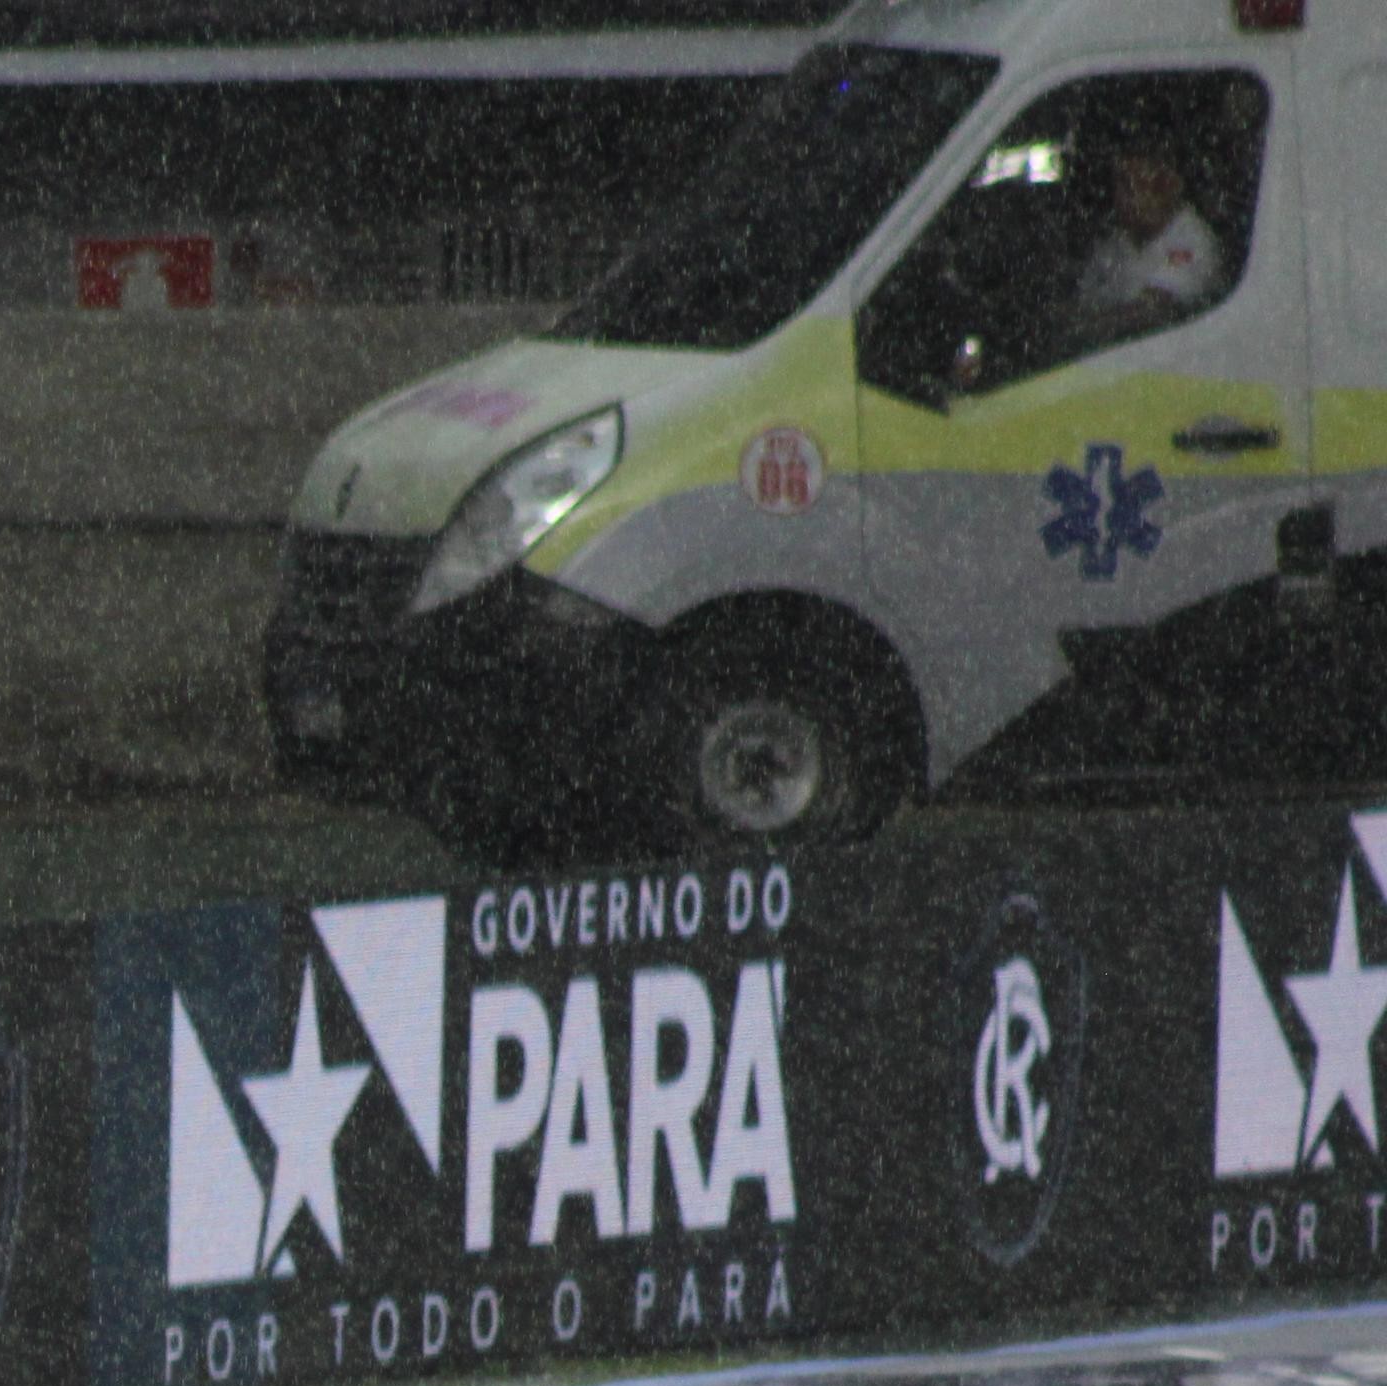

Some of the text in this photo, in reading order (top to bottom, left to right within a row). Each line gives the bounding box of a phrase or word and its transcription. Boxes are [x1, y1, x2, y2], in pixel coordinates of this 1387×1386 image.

[472, 864, 791, 958] GOVERNO DO
[1210, 1202, 1317, 1273] POR
[164, 1313, 278, 1386] POR
[329, 1286, 501, 1366] TODO
[552, 1278, 583, 1342] O
